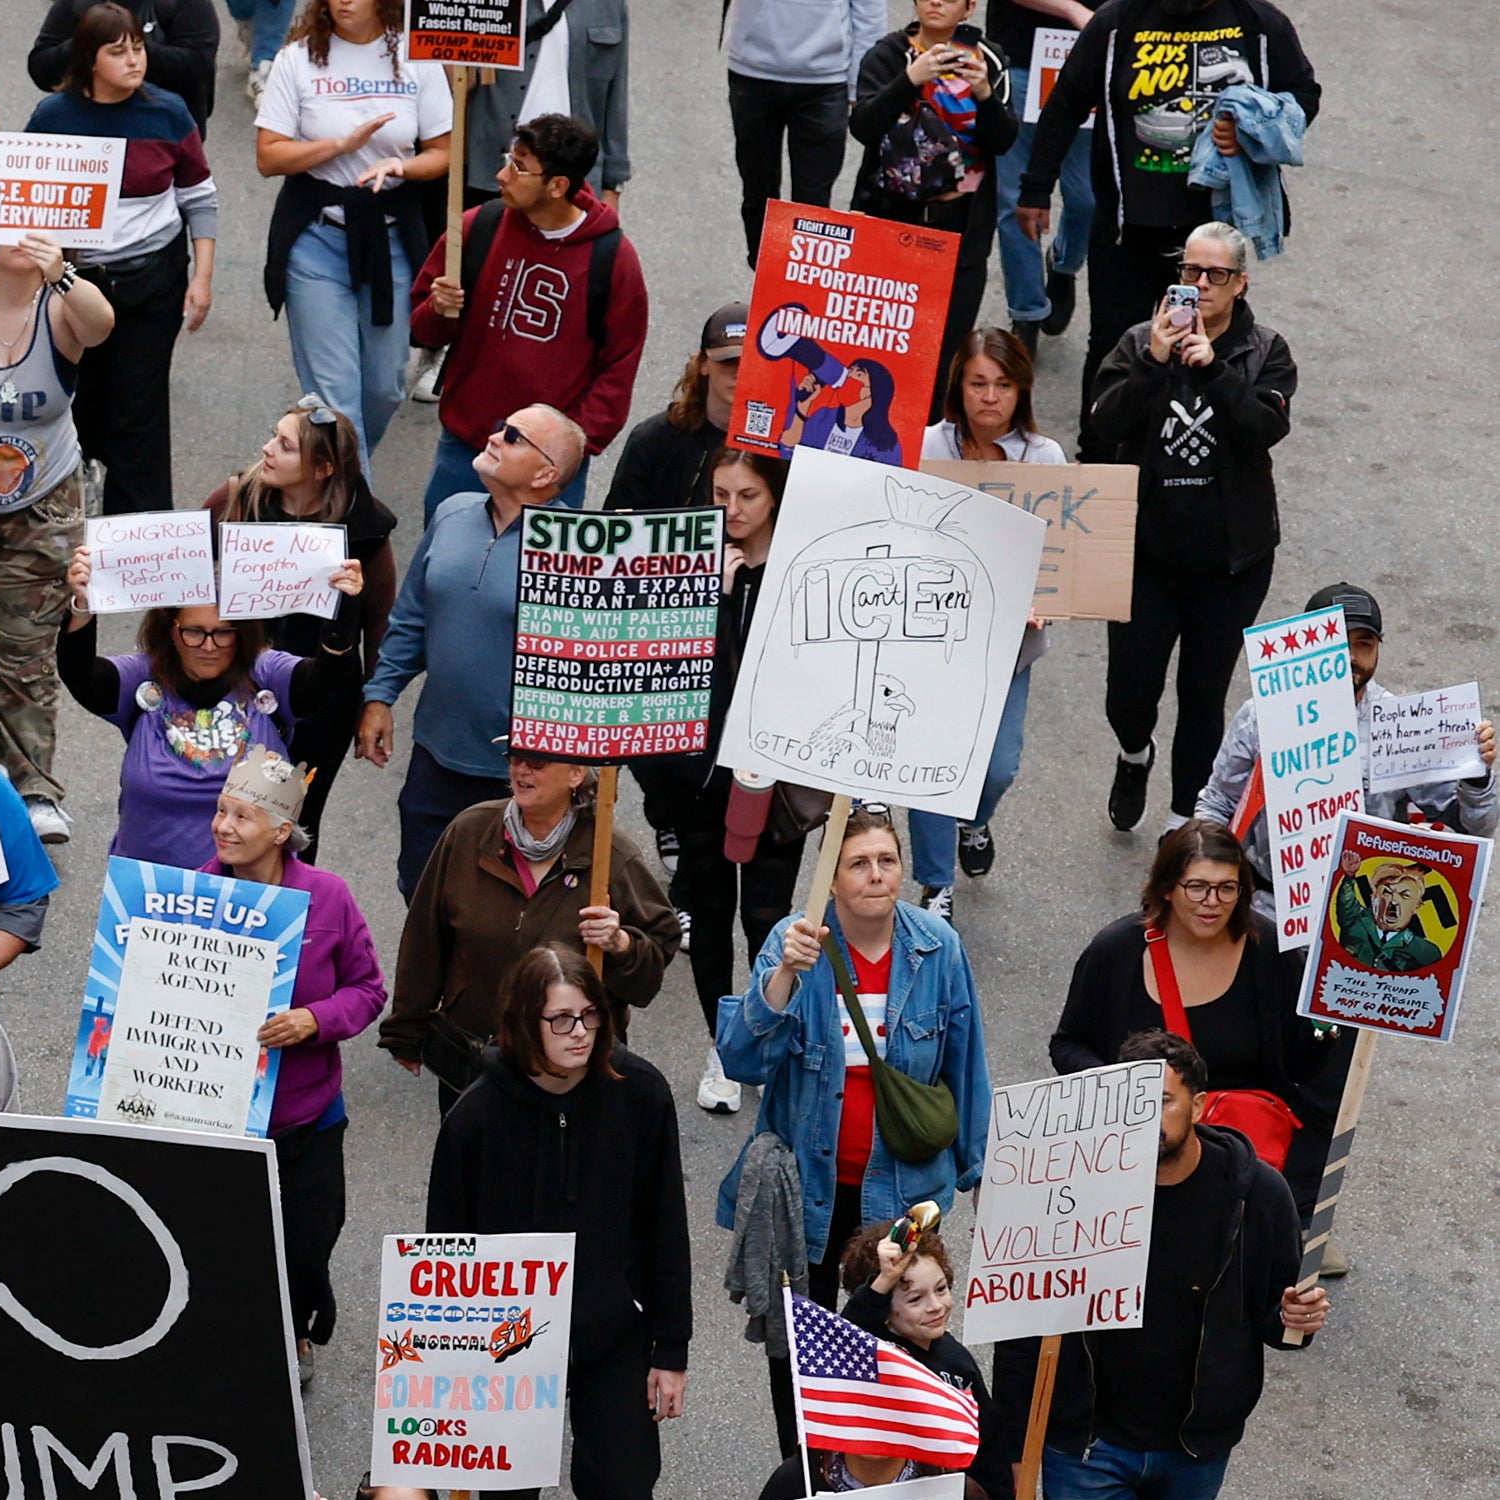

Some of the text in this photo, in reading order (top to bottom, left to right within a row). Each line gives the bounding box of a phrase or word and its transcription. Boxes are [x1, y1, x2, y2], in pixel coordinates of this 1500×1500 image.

[1257, 653, 1347, 697] CHICAGO
[1296, 698, 1319, 727] IS
[1271, 730, 1357, 777] UNITED
[1357, 831, 1463, 867] RefuseFascism.Org
[144, 893, 267, 929] RISE UP
[140, 926, 266, 961] STOP TRUMP'S
[168, 952, 231, 975] RACIST
[156, 972, 236, 997] AGENDA!
[149, 1011, 223, 1036] DEFEND
[126, 1027, 244, 1061] IMMIGRANTS
[158, 1056, 198, 1073] AND
[132, 1069, 224, 1099] WORKERS!
[994, 1063, 1162, 1140] WHITE
[991, 1128, 1142, 1185] SILENCE
[1047, 1186, 1076, 1215] IS
[397, 1237, 476, 1257] WHEN
[981, 1206, 1144, 1262] VIOLENCE
[410, 1260, 568, 1297] CRUELTY
[966, 1267, 1141, 1326] ABOLISH ICE!
[386, 1303, 522, 1323] BECOMES
[413, 1334, 488, 1351] NORMAL
[376, 1374, 559, 1412] COMPASSION
[388, 1417, 467, 1437] LOOKS
[392, 1440, 512, 1471] RADICAL
